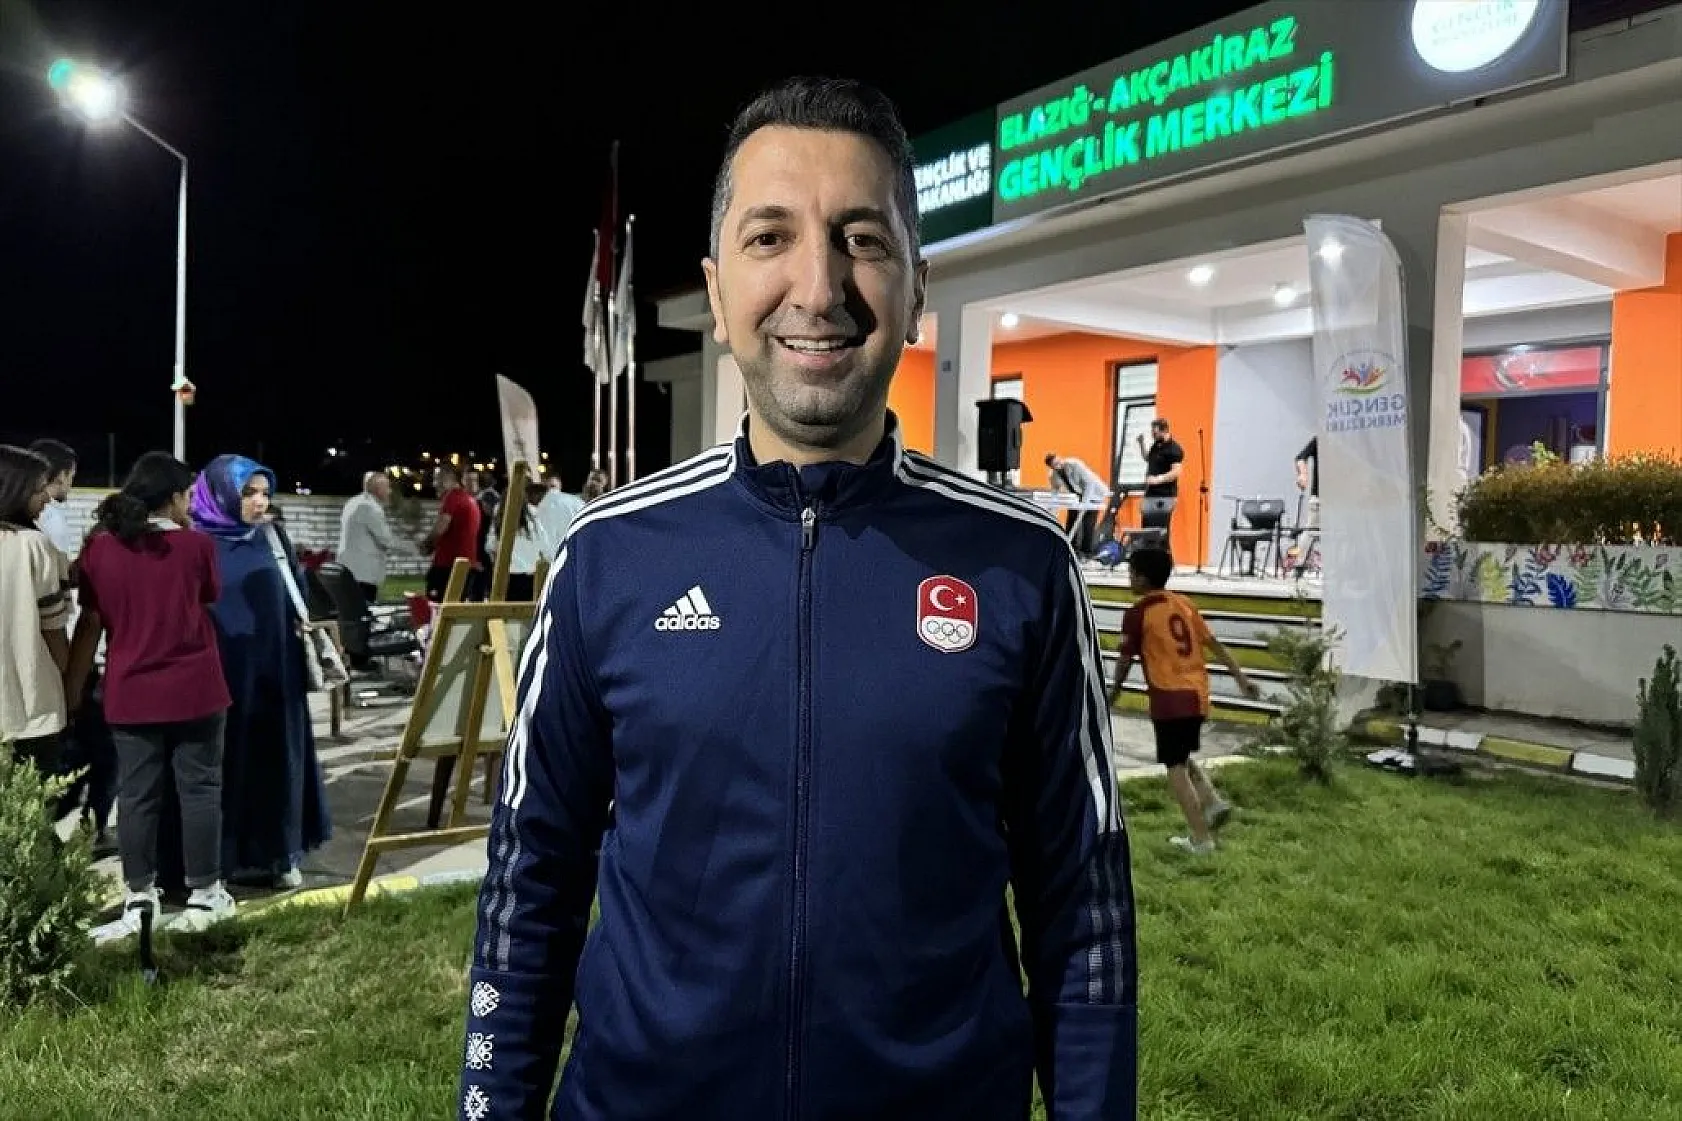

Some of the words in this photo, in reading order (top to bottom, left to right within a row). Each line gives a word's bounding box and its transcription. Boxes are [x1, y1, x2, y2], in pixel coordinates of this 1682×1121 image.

[1108, 15, 1297, 113] AKÇAKİRAZ
[998, 119, 1141, 202] GENÇLİK
[1145, 51, 1334, 159] MERKEZİ
[654, 614, 721, 630] adidas
[1168, 613, 1193, 657] 9
